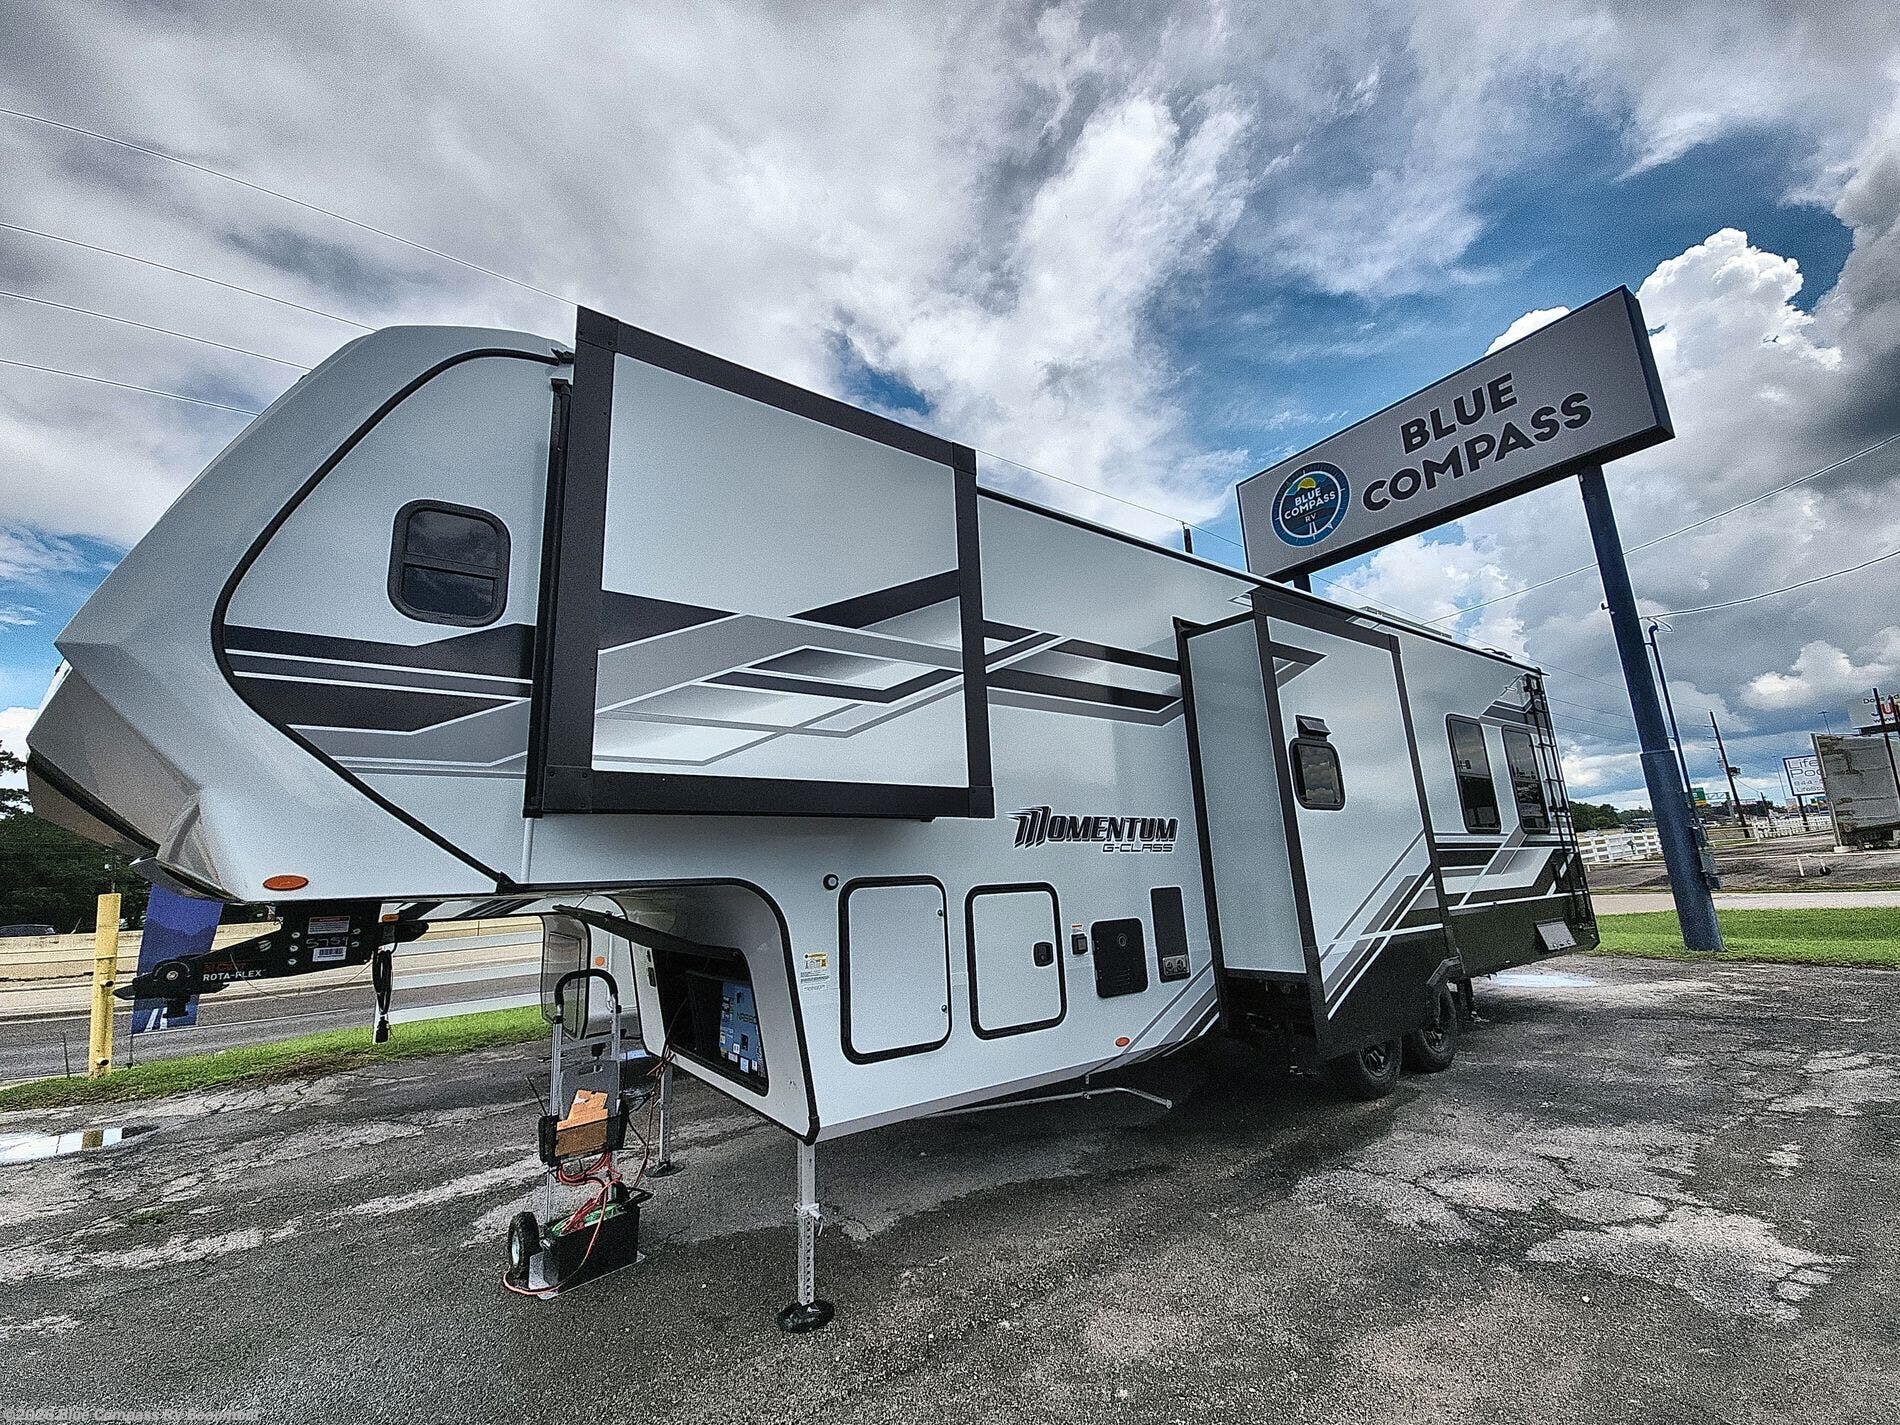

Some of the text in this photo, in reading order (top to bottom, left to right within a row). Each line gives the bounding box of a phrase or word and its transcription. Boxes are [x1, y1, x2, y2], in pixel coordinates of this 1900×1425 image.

[1400, 372, 1518, 454] BLUE
[1362, 392, 1592, 511] COMPASS
[1284, 491, 1336, 519] COMPASS
[1294, 487, 1322, 506] BLUE
[1304, 512, 1317, 523] RV
[1787, 759, 1818, 769] Life
[1004, 805, 1178, 848] MOMENTUM
[1102, 843, 1174, 853] G-CLASS
